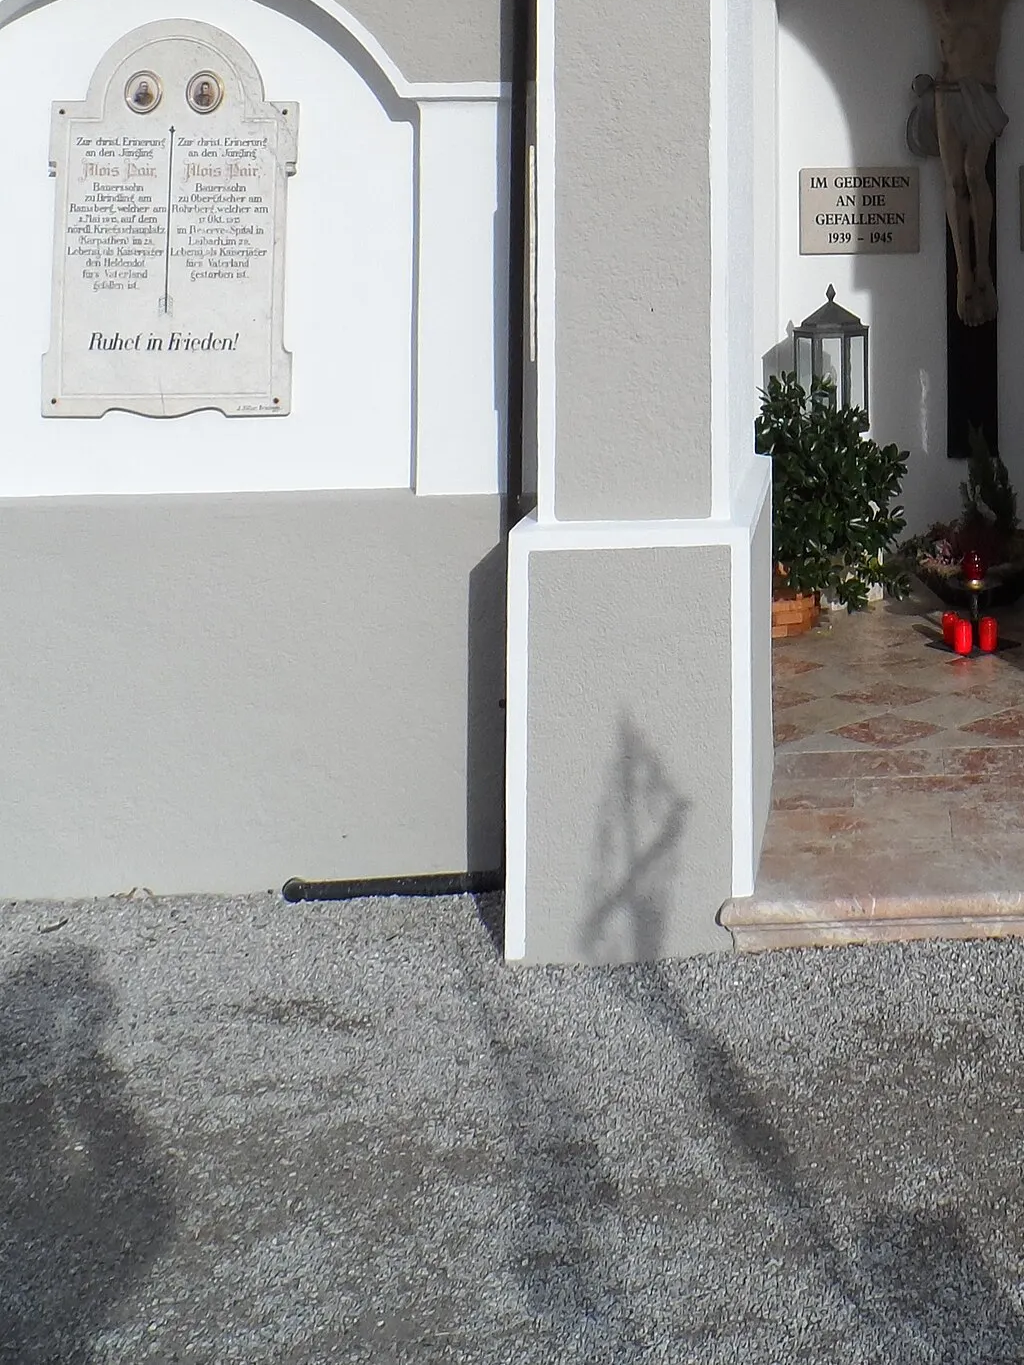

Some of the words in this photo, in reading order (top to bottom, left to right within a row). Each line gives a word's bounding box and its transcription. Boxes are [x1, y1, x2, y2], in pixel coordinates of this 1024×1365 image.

[76, 137, 92, 146] Zur
[177, 137, 194, 147] Zur
[99, 148, 115, 157] den
[201, 148, 217, 157] den
[810, 176, 828, 189] IM
[834, 176, 910, 189] GEDENKEN
[836, 194, 856, 206] AN
[862, 194, 886, 207] DIE
[118, 203, 150, 213] welcher
[217, 204, 251, 214] welcher
[121, 214, 136, 223] auf
[138, 214, 157, 223] dem
[815, 213, 905, 226] GEFALLENEN
[255, 226, 264, 234] in
[828, 232, 852, 244] 1939
[870, 232, 893, 244] 1945
[86, 258, 101, 267] den
[208, 259, 249, 268] Vaterland
[104, 269, 148, 278] Vaterland
[190, 270, 234, 282] gestorben
[88, 332, 143, 351] Ruhet
[146, 332, 163, 351] in
[167, 331, 241, 352] Frieden!
